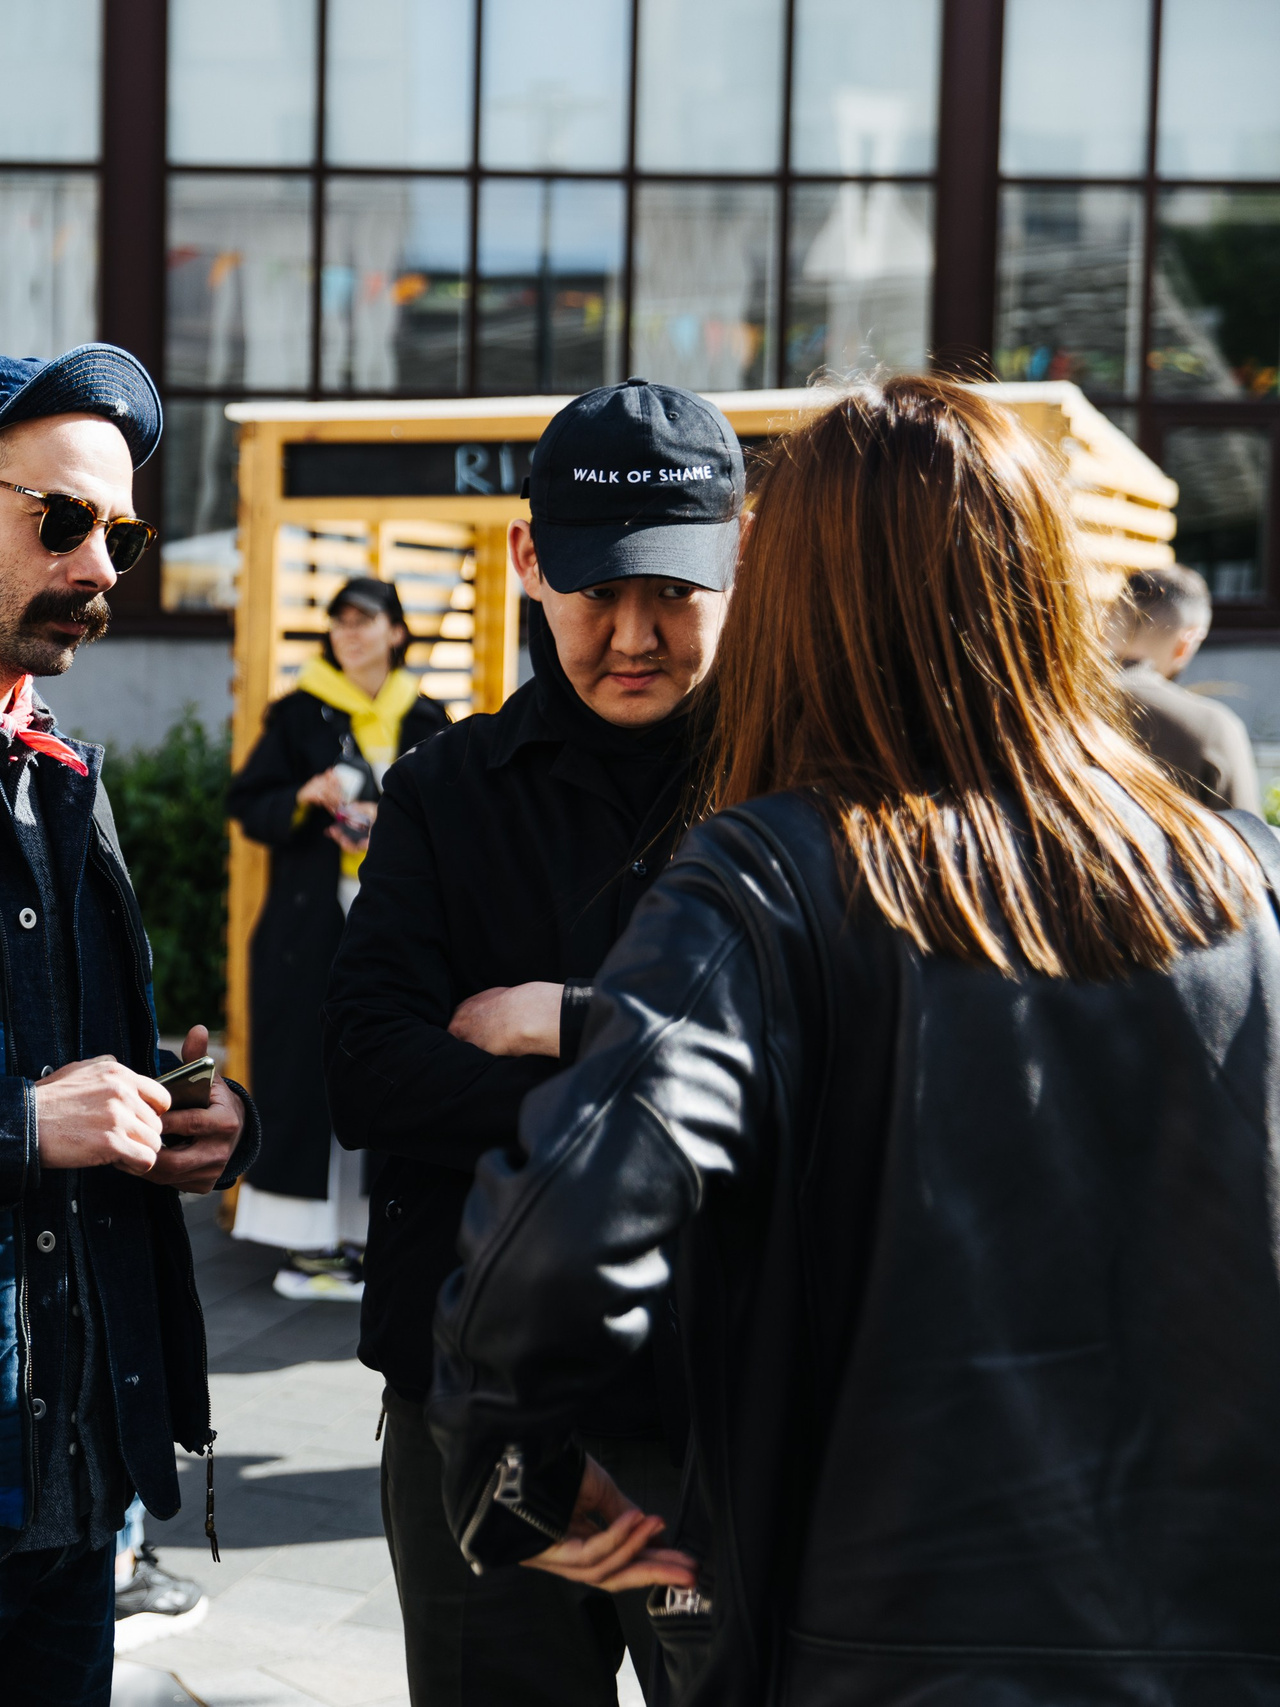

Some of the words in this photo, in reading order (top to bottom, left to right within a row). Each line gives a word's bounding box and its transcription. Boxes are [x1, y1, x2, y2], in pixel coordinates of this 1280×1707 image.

[455, 443, 536, 495] RI
[573, 468, 620, 484] WALK
[626, 470, 652, 484] OF
[658, 465, 713, 482] SHAME
